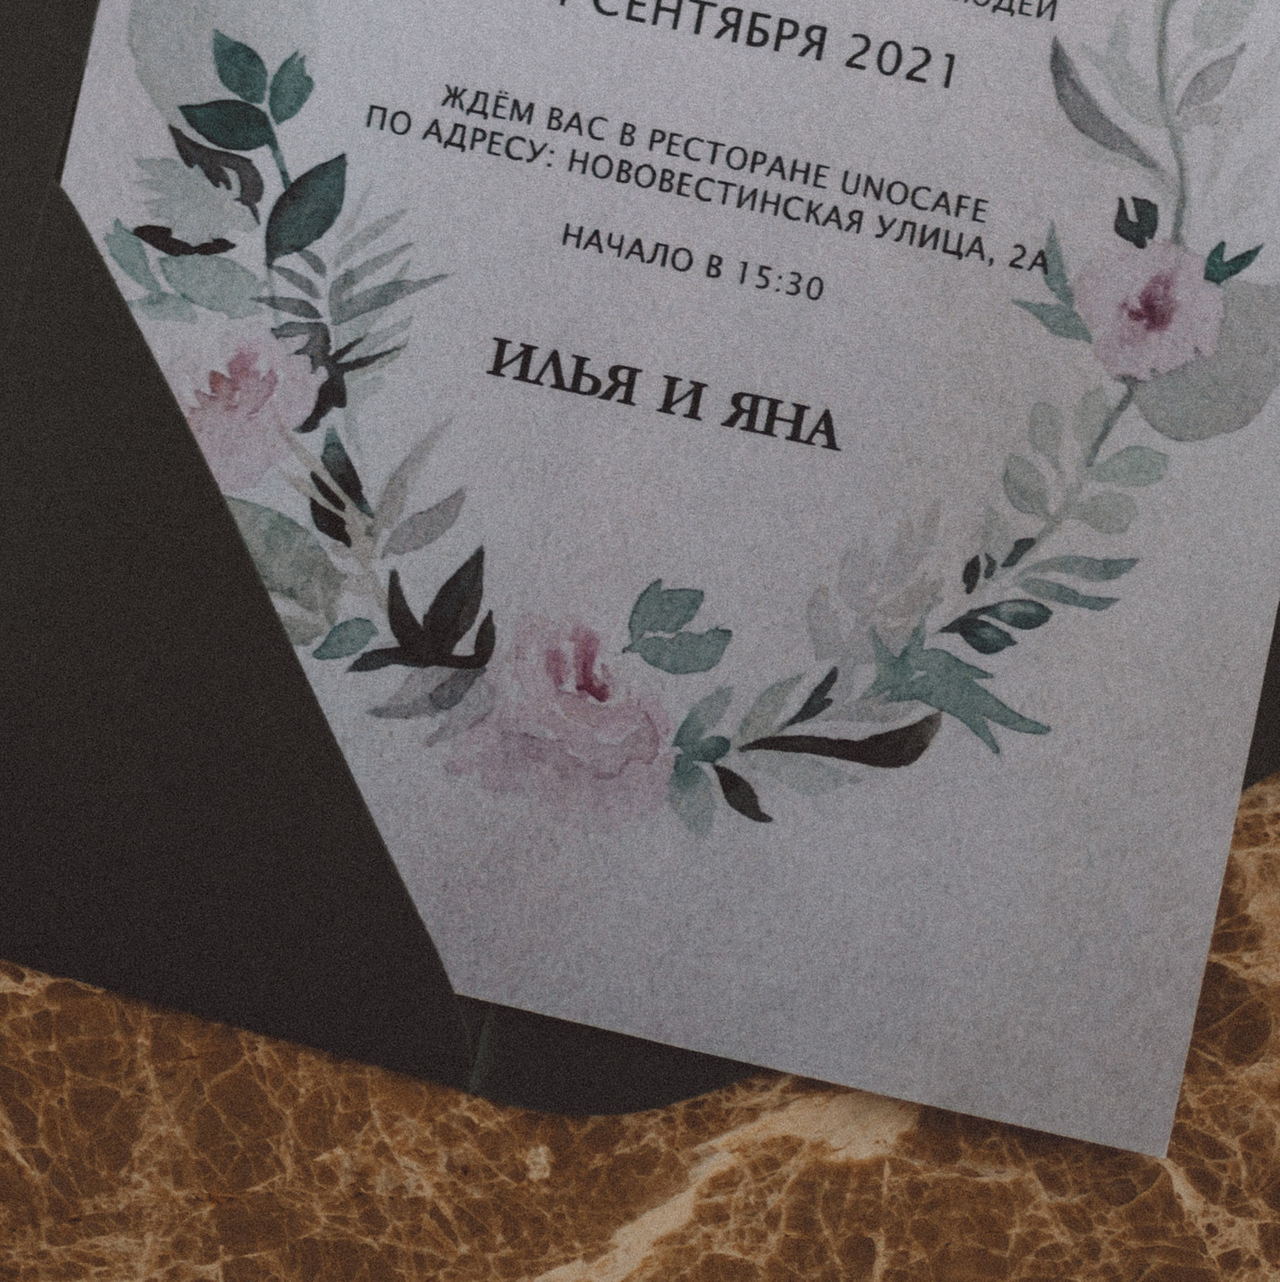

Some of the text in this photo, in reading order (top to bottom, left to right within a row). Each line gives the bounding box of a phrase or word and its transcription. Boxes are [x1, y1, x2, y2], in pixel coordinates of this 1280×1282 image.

[843, 31, 957, 90] 2021
[364, 103, 1051, 277] ПО АДРЕСУ: НОВОВЕСТИНСКАЯ УЛИЦА, 2А
[440, 82, 989, 224] ЖДЁМ ВАС В РЕСТОРАНЕ UNOCAFE
[560, 222, 826, 302] НАЧАЛО В 15:30
[485, 335, 842, 453] ИЛЬЯ И ЯНА
